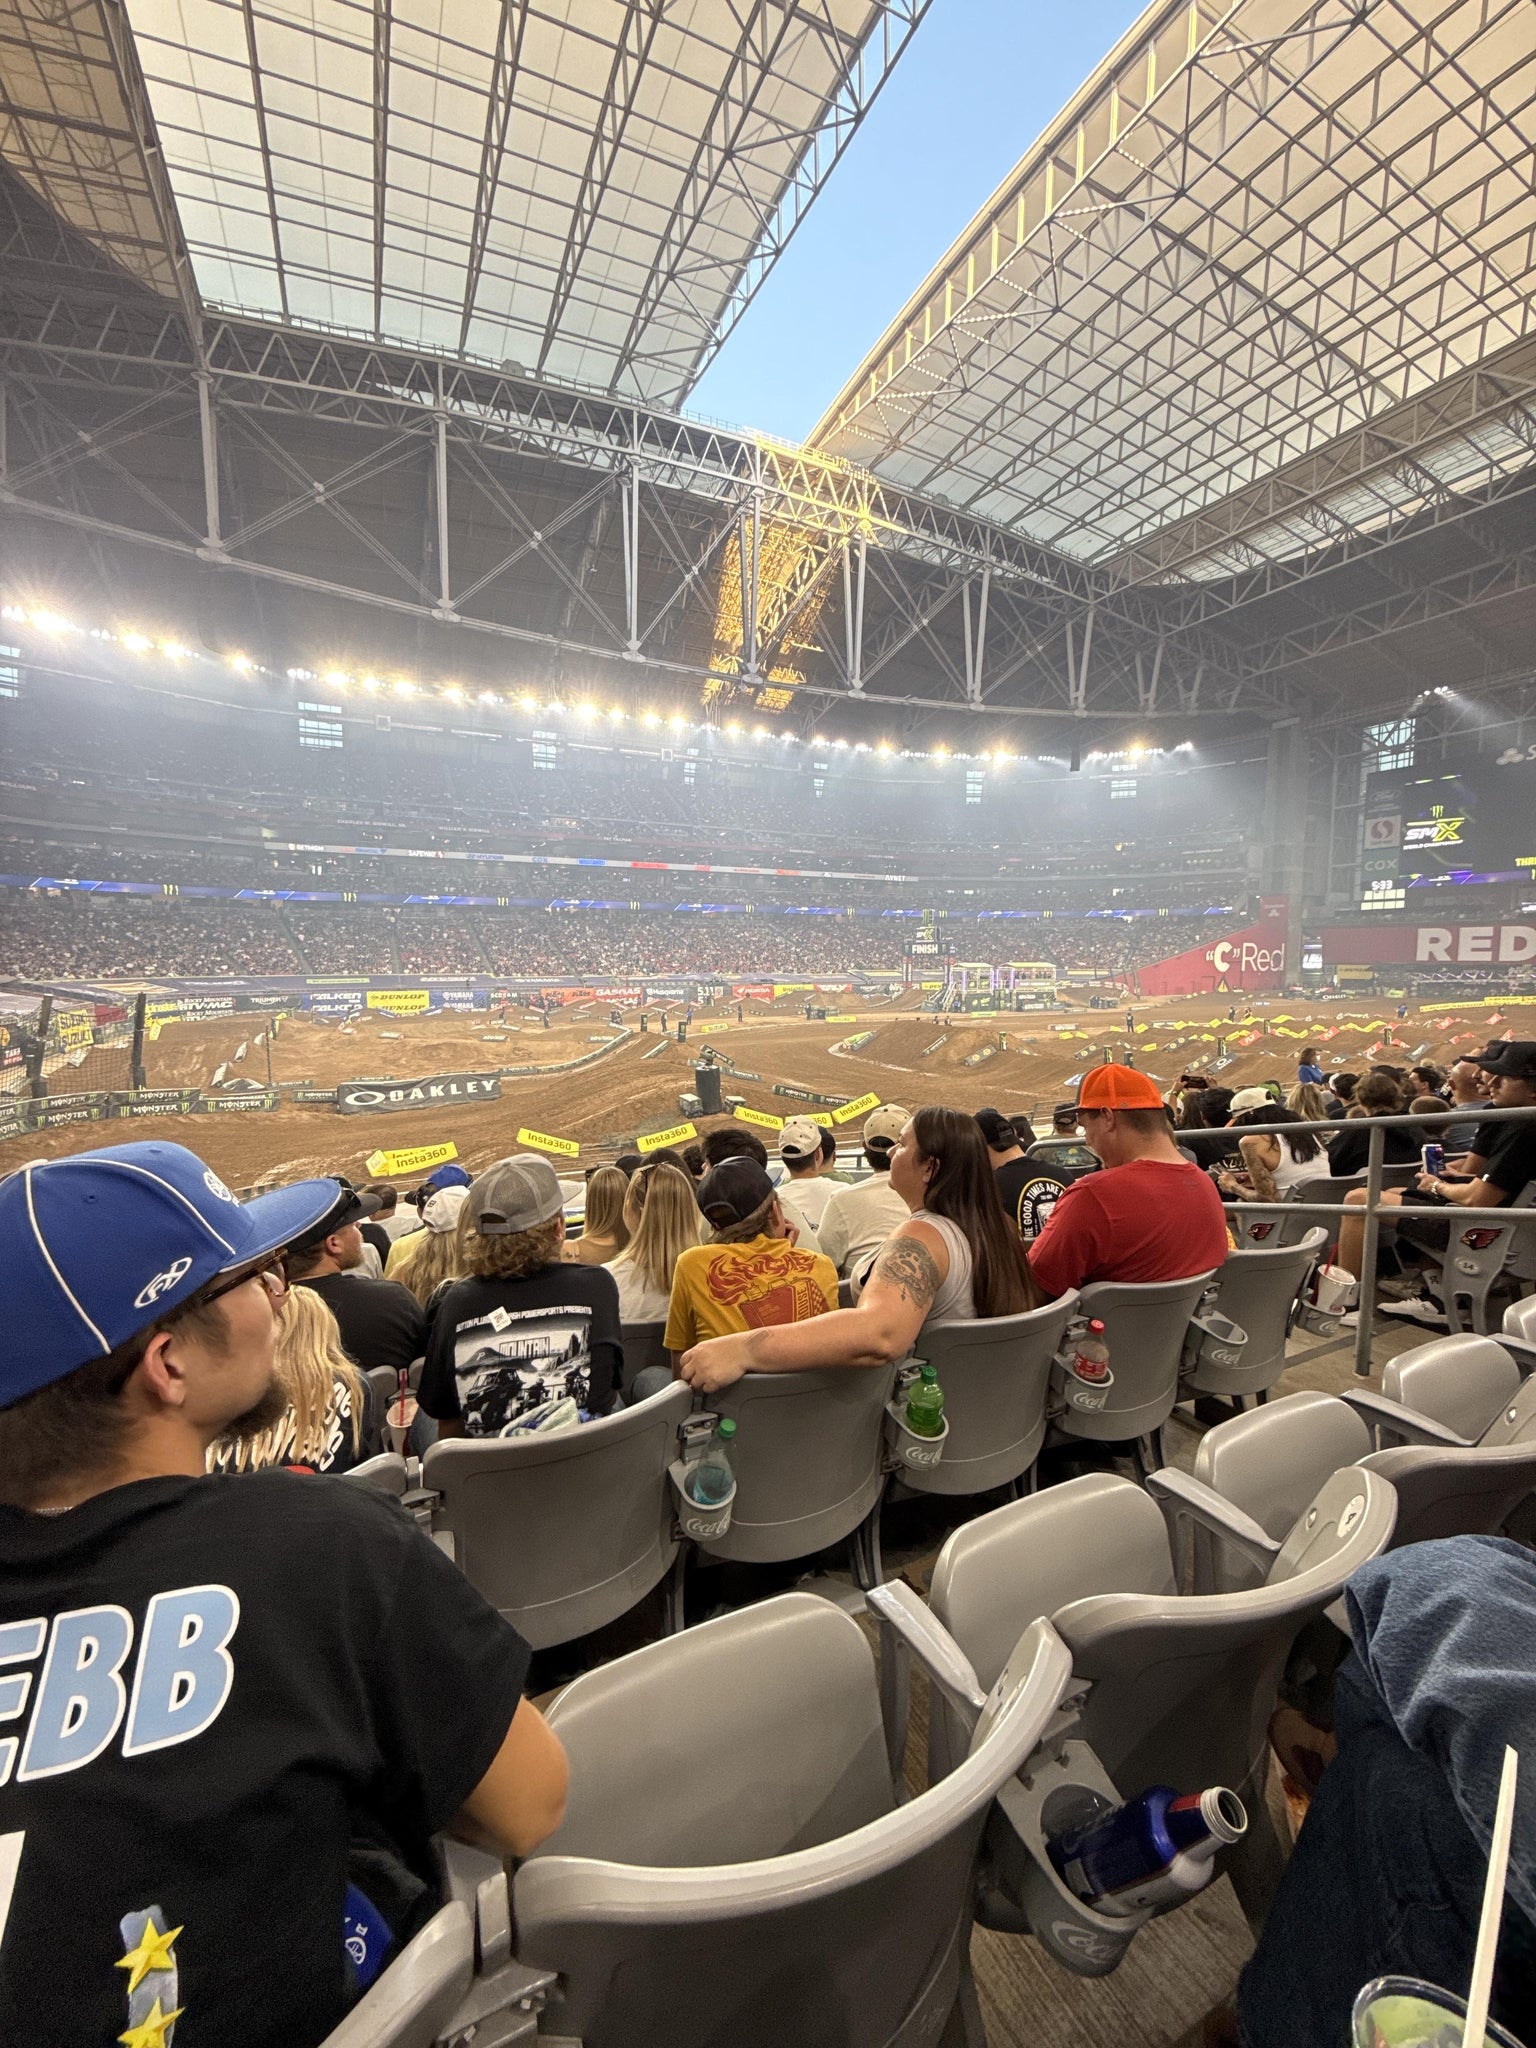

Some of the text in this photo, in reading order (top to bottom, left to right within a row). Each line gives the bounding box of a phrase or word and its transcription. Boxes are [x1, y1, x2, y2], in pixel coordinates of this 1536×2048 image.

[1404, 820, 1460, 841] SMX
[1365, 859, 1399, 870] COX
[912, 944, 939, 954] FINISH
[1415, 925, 1536, 961] RED
[1241, 942, 1285, 971] Red
[596, 987, 641, 995] GASGAS
[60, 1030, 91, 1049] SUZUKI
[140, 1091, 179, 1099] MONSTER
[390, 1080, 495, 1101] OAKLEY
[50, 1096, 87, 1106] MONSTER
[133, 1103, 178, 1114] MONSTER
[219, 1099, 262, 1108] MONSTER
[840, 1096, 873, 1117] Insta360
[48, 1111, 89, 1122] MONSTER
[743, 1111, 778, 1126] Insta360
[528, 1132, 572, 1151] Insta360
[644, 1126, 692, 1147] Insta360
[396, 1147, 447, 1168] Insta360
[1026, 1182, 1046, 1200] TIMES
[1046, 1183, 1060, 1195] ARE
[1023, 1200, 1033, 1225] GOOD
